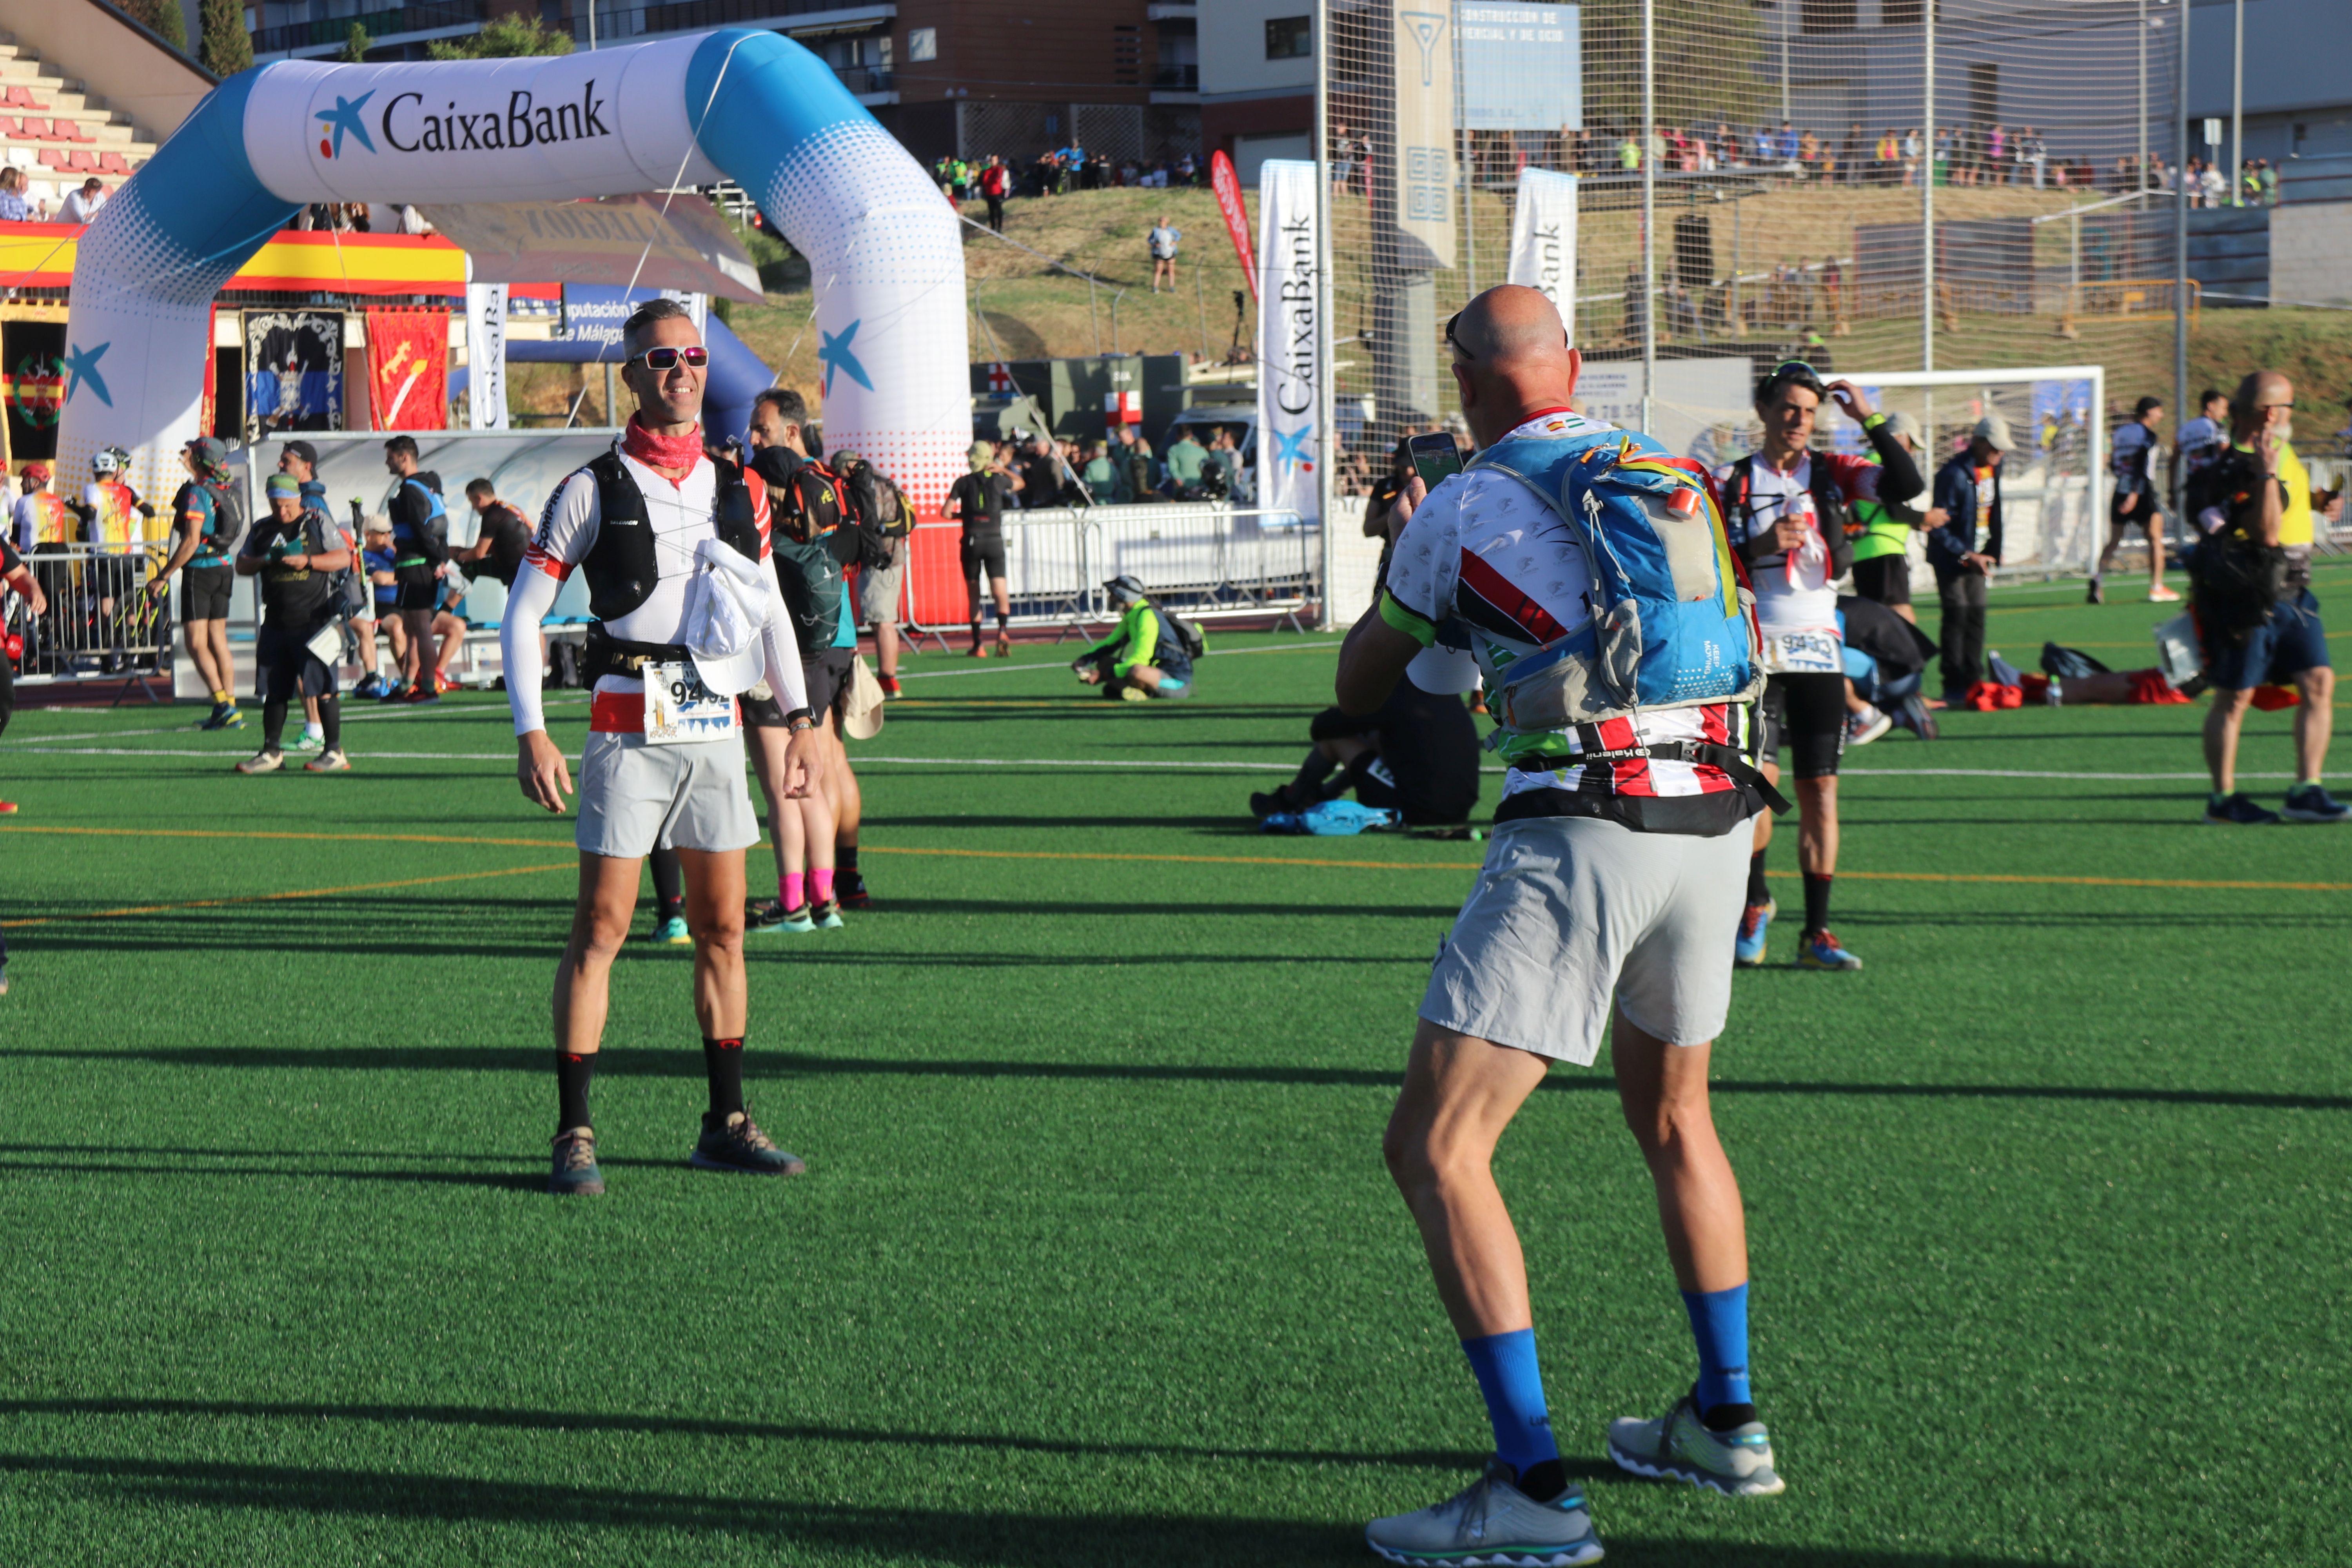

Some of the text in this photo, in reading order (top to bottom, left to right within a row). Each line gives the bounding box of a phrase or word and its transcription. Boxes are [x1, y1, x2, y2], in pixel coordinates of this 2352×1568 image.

[383, 78, 611, 152] CaixaBank
[1278, 214, 1313, 415] CaixaBank
[1703, 640, 1712, 675] MOVING
